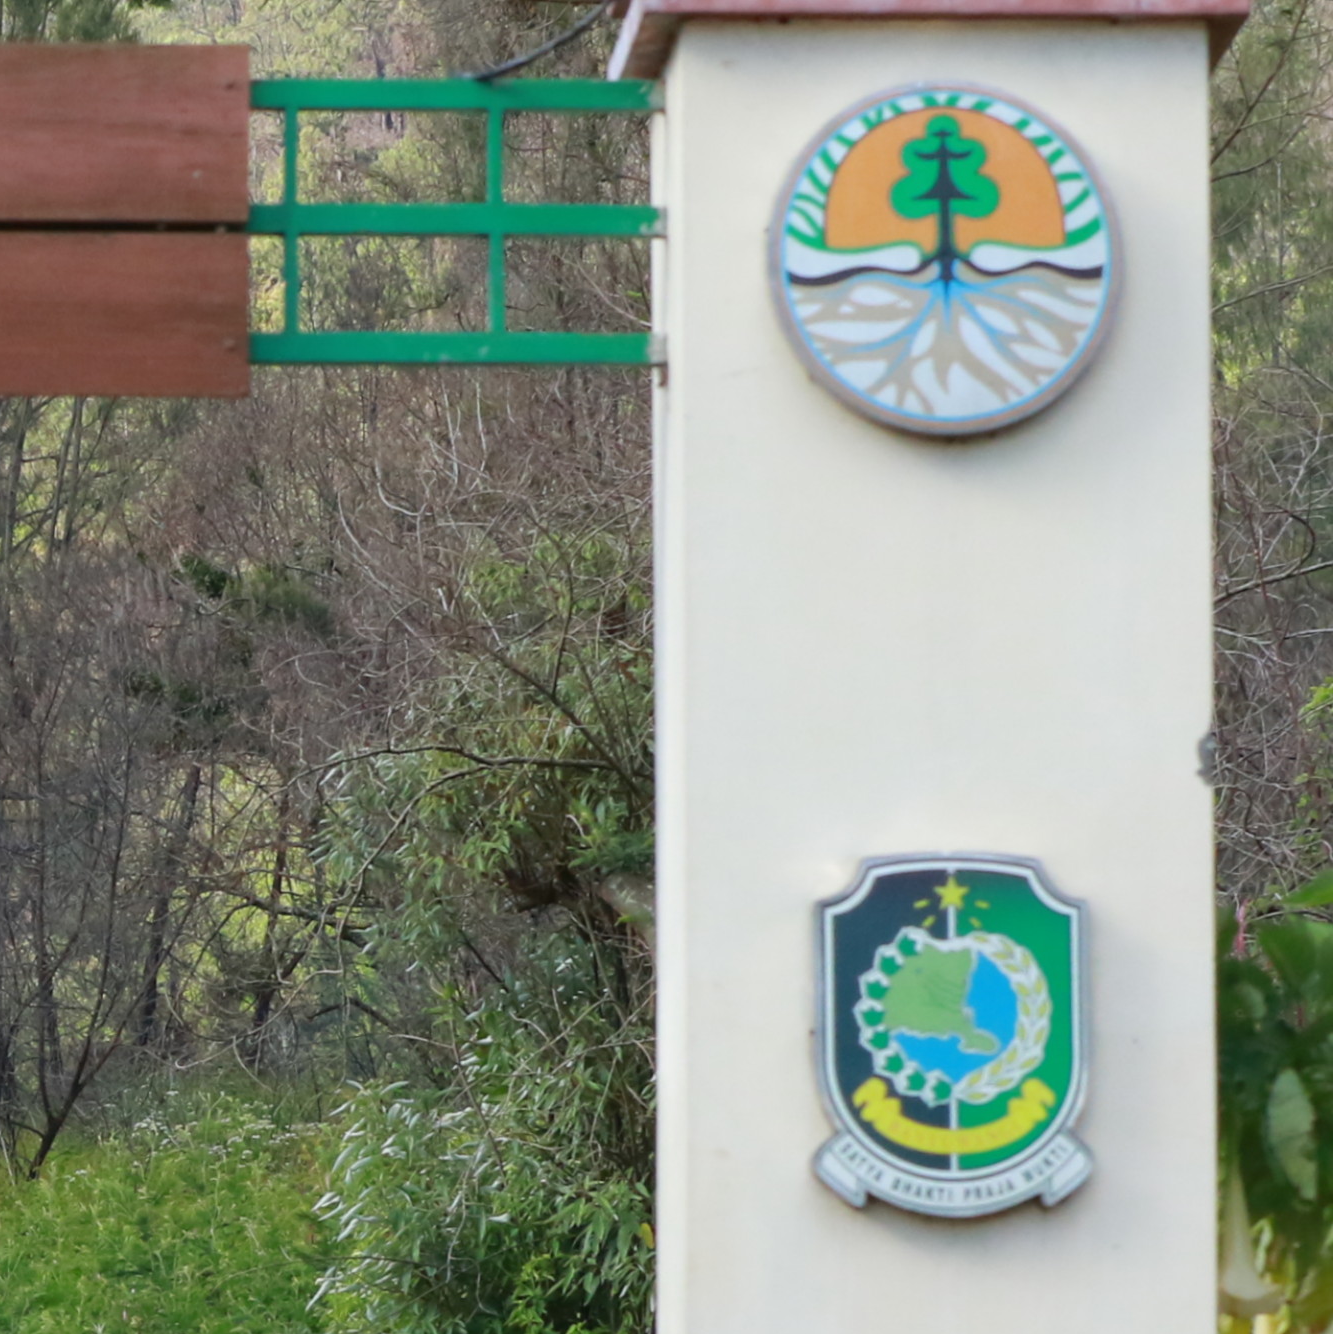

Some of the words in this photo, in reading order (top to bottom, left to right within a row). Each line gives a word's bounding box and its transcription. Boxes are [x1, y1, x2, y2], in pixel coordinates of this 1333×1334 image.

[840, 1142, 883, 1182] SATYA
[891, 1177, 953, 1201] BHAKTI
[963, 1179, 1015, 1201] PRAJA
